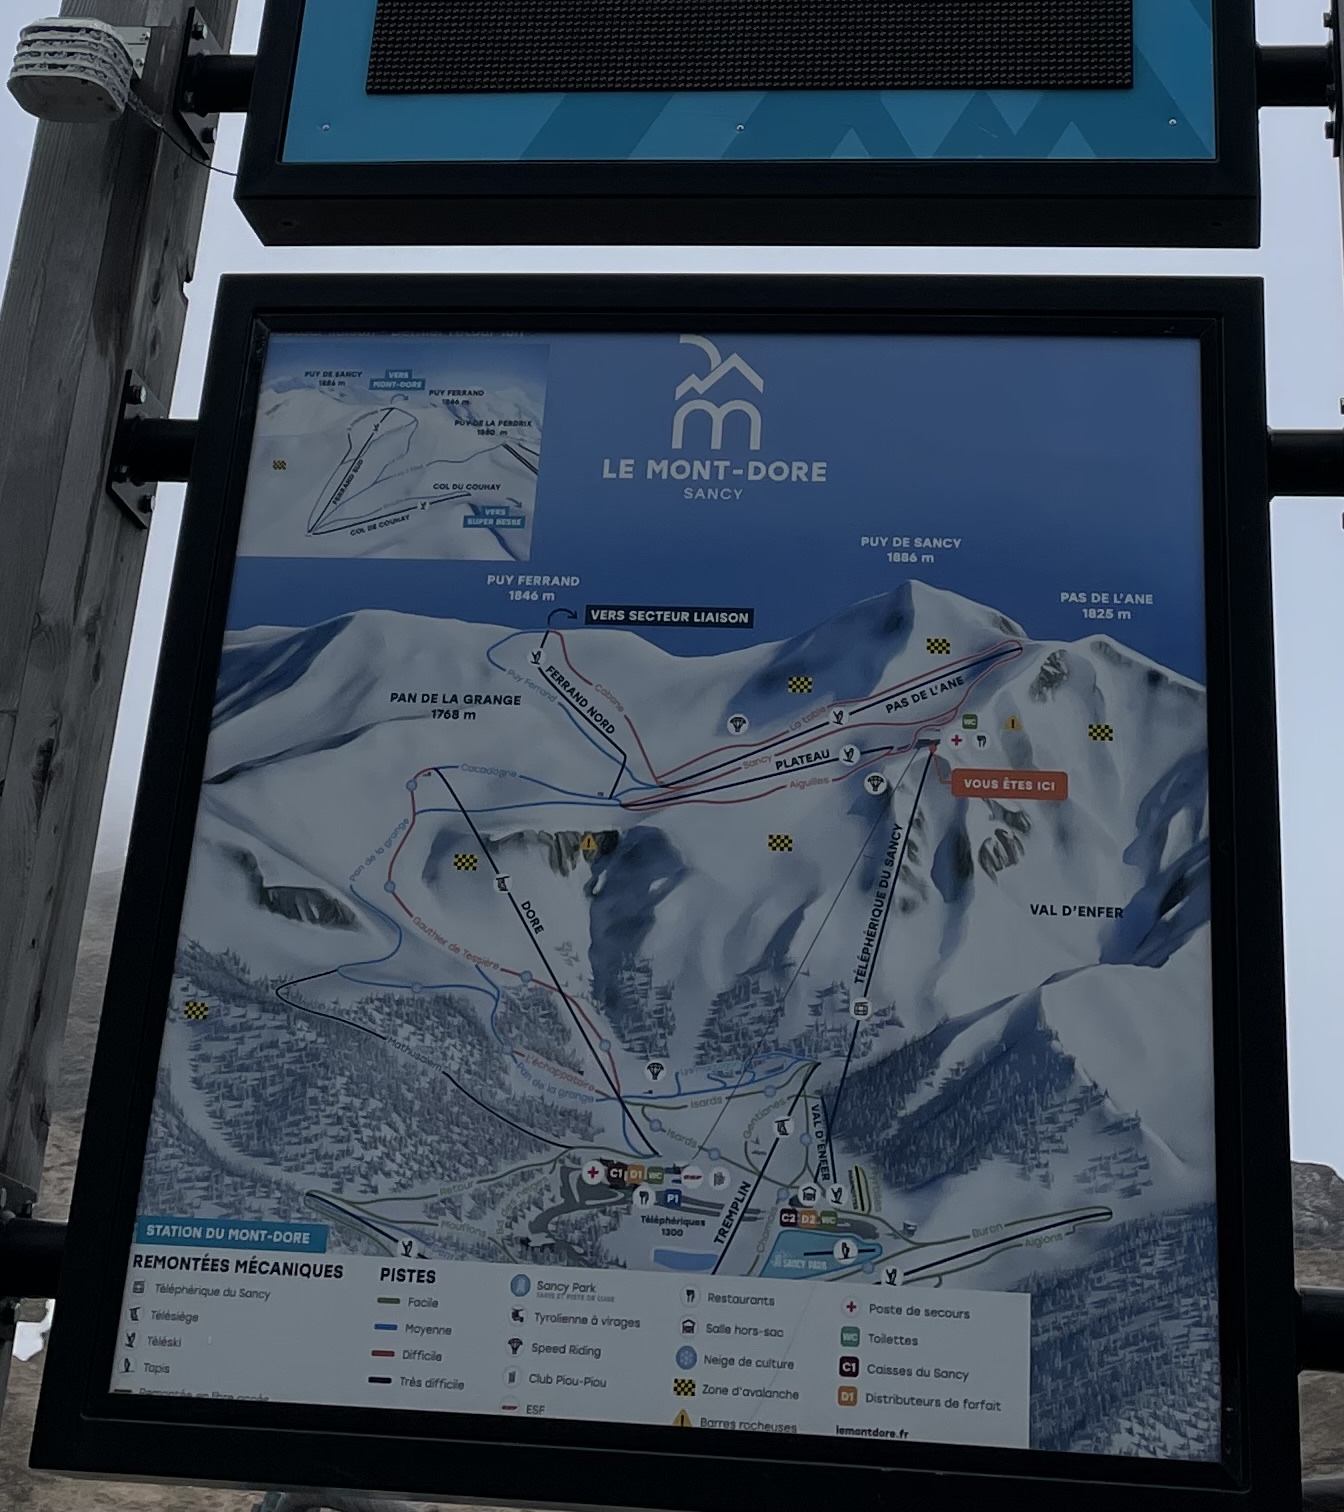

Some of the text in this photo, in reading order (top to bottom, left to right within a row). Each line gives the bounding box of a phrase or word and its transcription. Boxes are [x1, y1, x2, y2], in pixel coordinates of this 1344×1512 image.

[304, 370, 363, 379] PUY DE SANCY
[388, 371, 409, 379] VERS
[373, 380, 423, 389] MONT-DORE
[429, 390, 485, 398] PUY FERRAND
[454, 420, 532, 428] PUY DE LA PERDRIX
[602, 458, 827, 483] LE MONT-DORE
[332, 473, 356, 506] FERRAND
[433, 483, 450, 491] COL
[452, 483, 464, 491] DU
[683, 487, 743, 501] SANCY
[485, 508, 506, 516] VERS
[467, 518, 492, 526] SUPER
[349, 523, 378, 536] COL DE
[861, 536, 962, 550] PUY DE SANCY
[887, 552, 935, 564] 1886 m
[487, 574, 580, 587] PUY FERRAND
[509, 590, 555, 601] 1846 m
[1060, 591, 1088, 604] PAS
[1091, 592, 1110, 604] DE
[591, 609, 749, 625] VERS SECTEUR LIAISON
[1082, 608, 1131, 620] 1825 m
[507, 668, 558, 703] Puy Ferrand
[390, 692, 522, 706] PAN DE LA GRANGE
[544, 665, 616, 735] FERRAND NORD
[886, 697, 910, 714] PAS
[910, 689, 929, 704] DE
[431, 709, 476, 720] 1768 m
[963, 717, 978, 727] WC
[742, 754, 773, 771] Sancy
[775, 749, 830, 770] PLATEAU
[964, 776, 1056, 792] VOUS ÊTES ICI
[853, 822, 904, 985] TÉLÉPHÉRIQUE DU SANCY
[1030, 904, 1057, 917] VAL
[521, 900, 545, 936] DORE
[412, 916, 461, 955] Gauthier de
[811, 1104, 822, 1128] VAL
[609, 1168, 624, 1179] C1
[629, 1169, 643, 1179] D1
[666, 1193, 680, 1204] P1
[713, 1181, 752, 1246] TREMPLIN
[781, 1213, 796, 1224] C2
[801, 1213, 816, 1224] D2
[641, 1215, 706, 1227] Téléphériques
[146, 1224, 310, 1245] STATION DU MONT-DORE
[661, 1228, 684, 1237] 1300
[132, 1253, 344, 1279] REMONTÉES MÉCANIQUES
[380, 1267, 436, 1284] PISTES
[155, 1283, 272, 1302] Téléphérique du Sancy
[537, 1280, 597, 1295] Sancy Park
[408, 1297, 439, 1309] Facile
[708, 1292, 775, 1306] Restaurants
[151, 1310, 199, 1324] Télésiège
[869, 1303, 971, 1319] Poste de secours
[534, 1312, 588, 1326] Tyrolienne
[601, 1316, 641, 1330] virages
[405, 1323, 453, 1337] Moyenne
[706, 1323, 784, 1338] Salle hors-sac
[147, 1335, 182, 1348] Téléski
[842, 1331, 919, 1346] WC Toilettes
[402, 1349, 442, 1362] Difficile
[532, 1343, 601, 1359] Speed Riding
[143, 1362, 170, 1376] Tapis
[704, 1354, 795, 1370] Neige de culture
[841, 1361, 969, 1383] C1 Caisses du Sancy
[400, 1376, 465, 1391] Très difficile
[529, 1373, 607, 1388] Club Piou-Piou
[702, 1384, 729, 1395] Zone
[840, 1391, 1002, 1412] D1 Distributeurs de forfait
[526, 1404, 546, 1415] ESF
[700, 1417, 798, 1433] Barres rocheuses
[835, 1424, 909, 1439] lemontdore.fr
